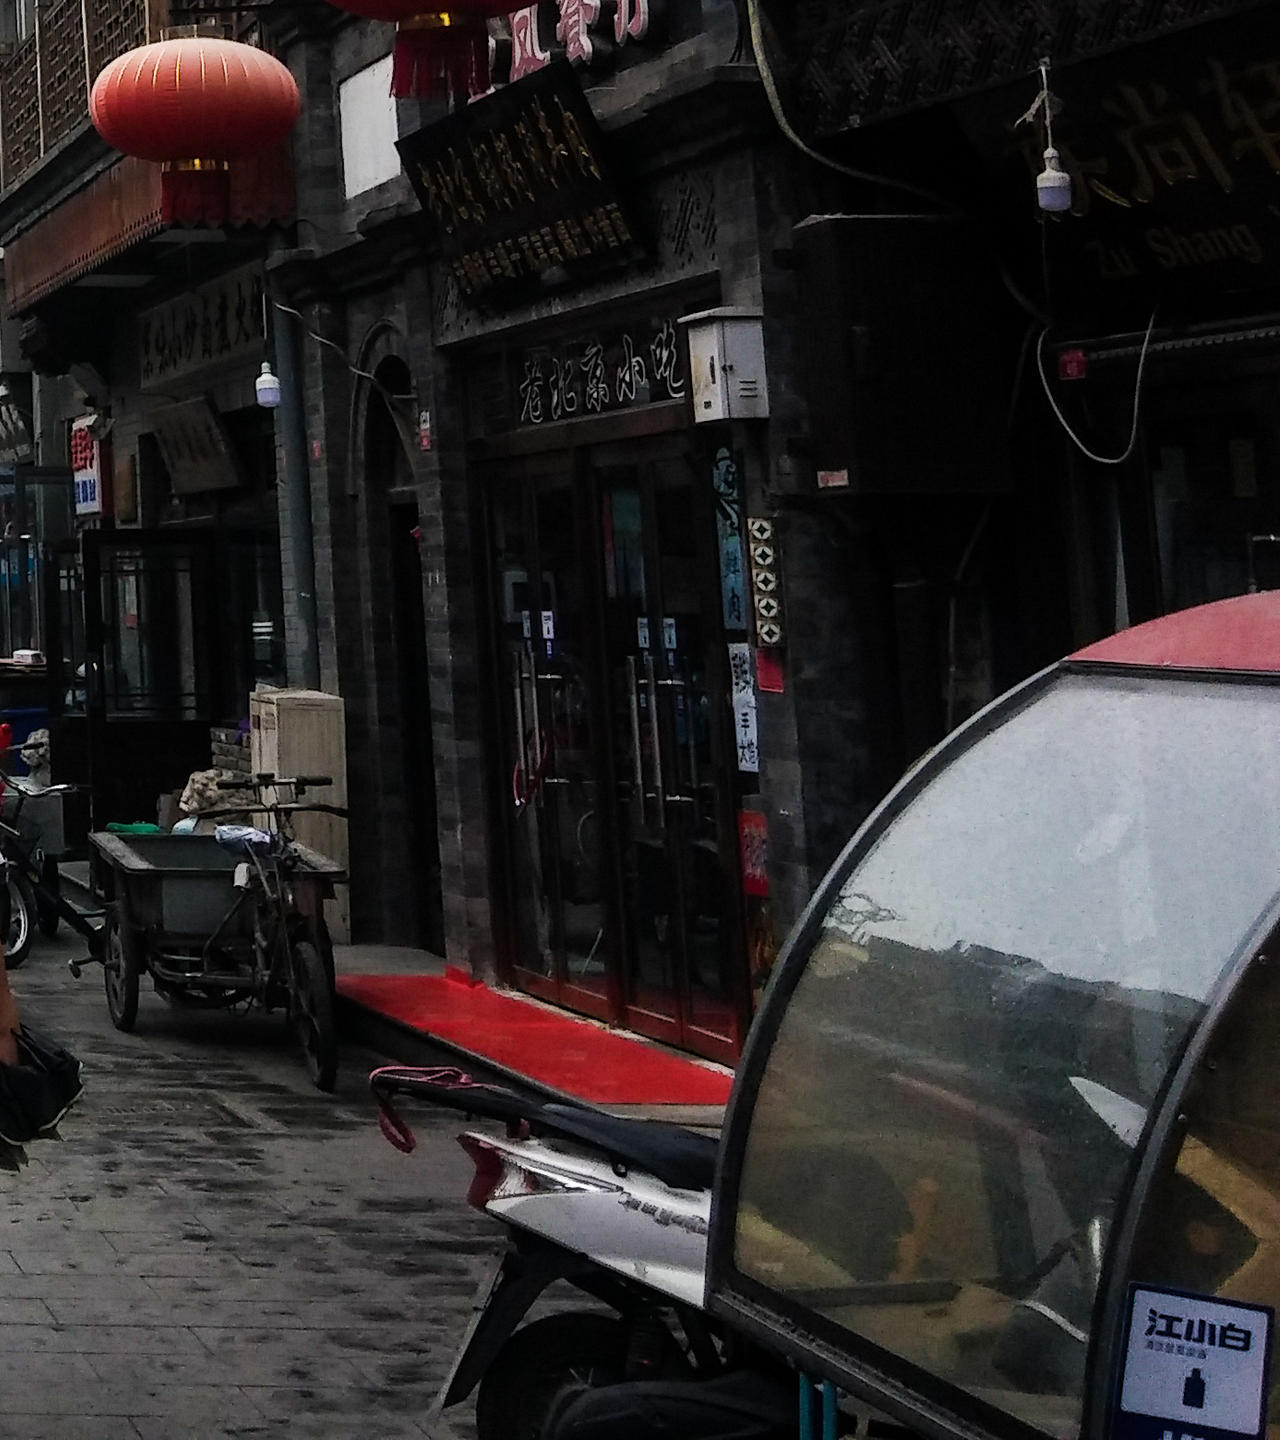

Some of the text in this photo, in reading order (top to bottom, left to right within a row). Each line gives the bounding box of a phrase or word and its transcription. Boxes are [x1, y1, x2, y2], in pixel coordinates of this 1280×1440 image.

[1145, 224, 1264, 269] Shang
[520, 319, 685, 424] 老北京小吃
[1144, 1308, 1252, 1352] 江小白
